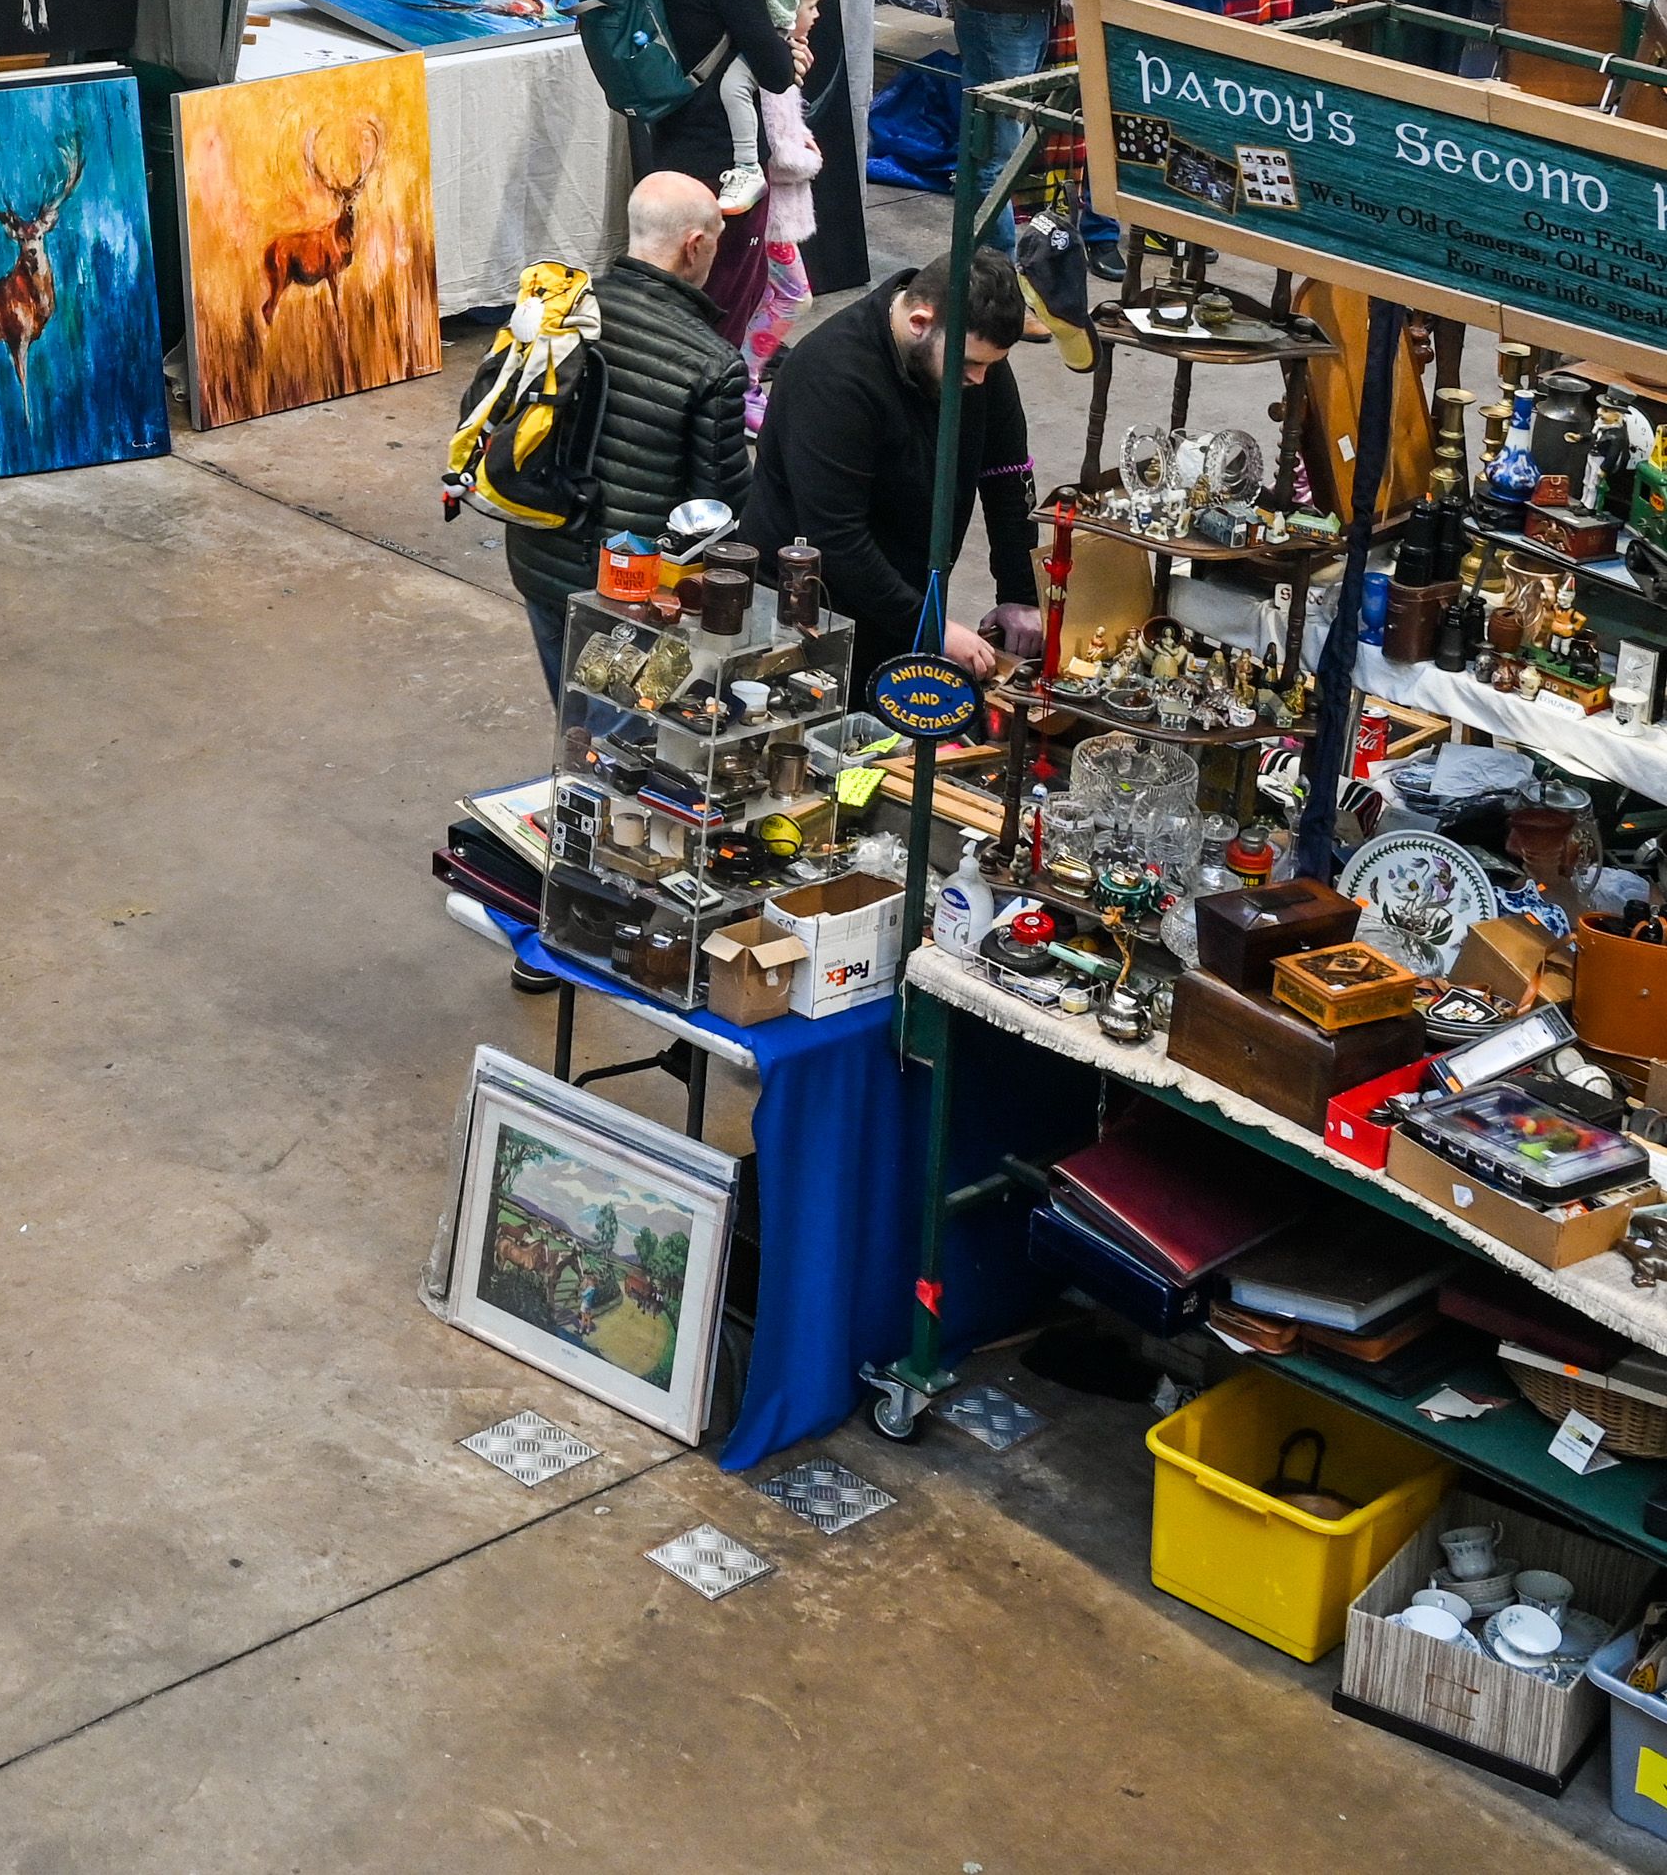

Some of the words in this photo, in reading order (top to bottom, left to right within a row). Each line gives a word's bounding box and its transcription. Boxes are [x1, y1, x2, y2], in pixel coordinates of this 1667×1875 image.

[1308, 180, 1344, 208] We
[1351, 191, 1390, 224] buy
[1397, 205, 1438, 234] Old
[1445, 219, 1548, 266] Cameras,
[1555, 250, 1599, 279] Old
[1608, 267, 1667, 299] Fishi
[1523, 211, 1586, 246] Open
[1446, 248, 1485, 275] For
[1491, 266, 1548, 294] more
[1555, 278, 1599, 309] info
[610, 565, 645, 580] French
[889, 665, 964, 688] ANTIQUES
[879, 693, 975, 729] COLLECTABLES
[909, 691, 940, 706] AND
[826, 959, 870, 987] FedEx
